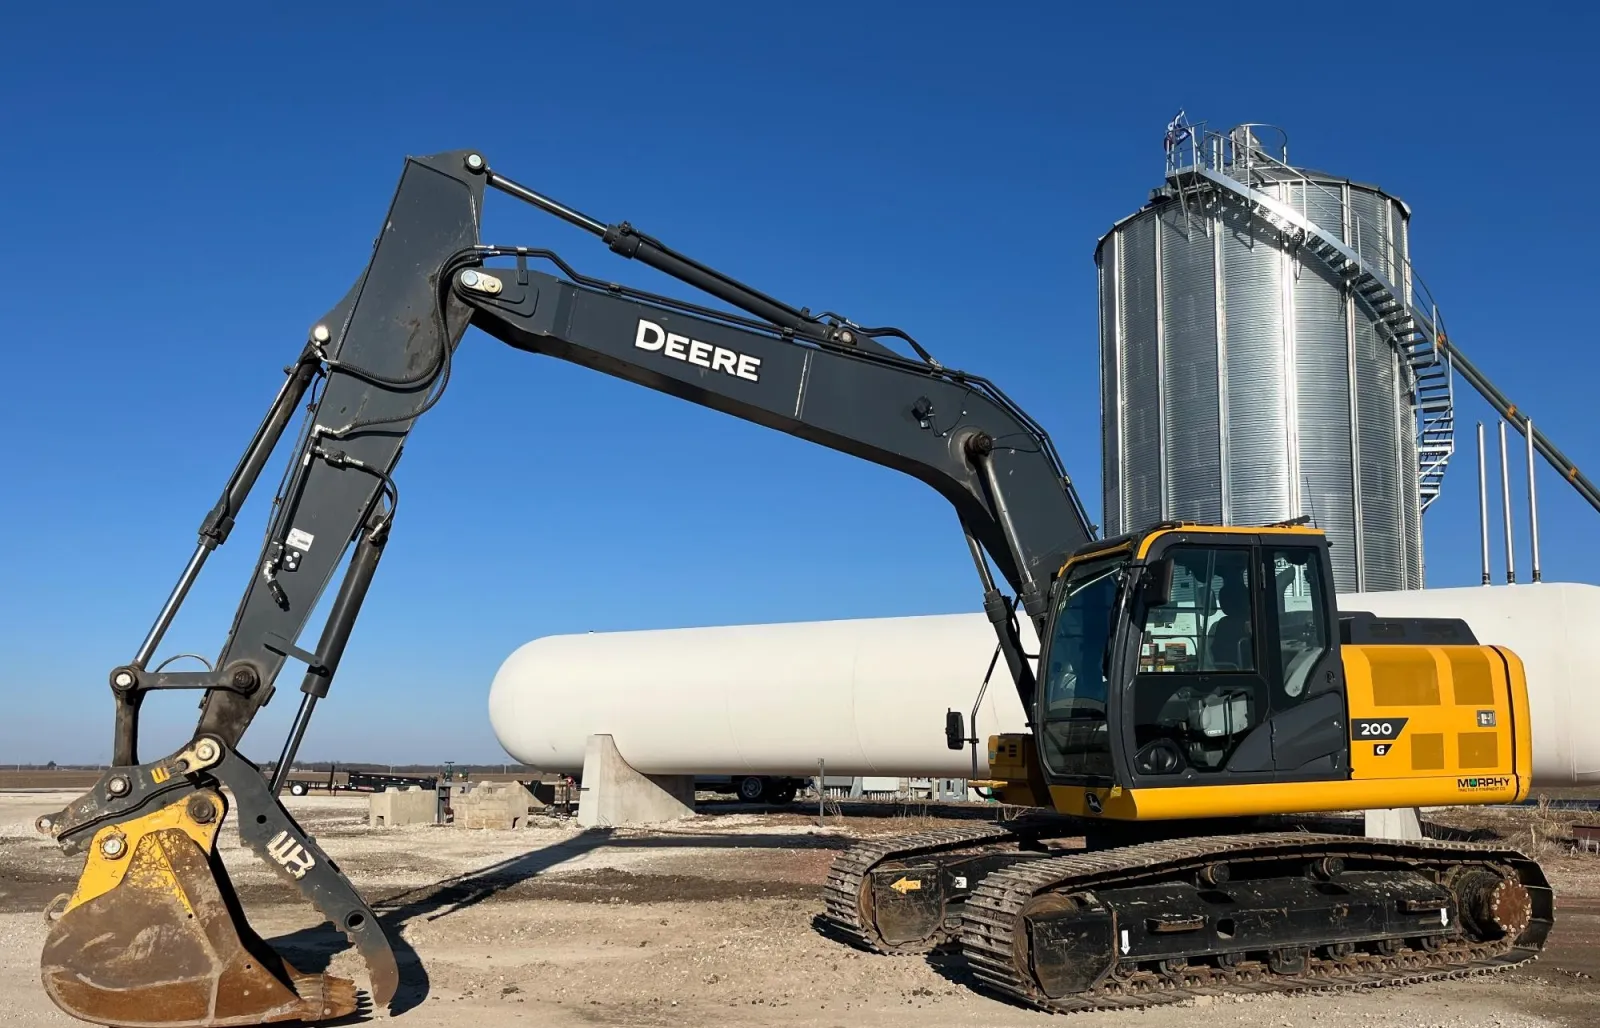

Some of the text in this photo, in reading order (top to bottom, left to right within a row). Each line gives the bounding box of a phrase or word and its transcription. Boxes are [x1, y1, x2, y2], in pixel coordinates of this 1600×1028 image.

[635, 319, 761, 381] DEERE
[1361, 723, 1392, 735] 200
[1376, 745, 1385, 755] G
[1457, 777, 1510, 787] MURPHY
